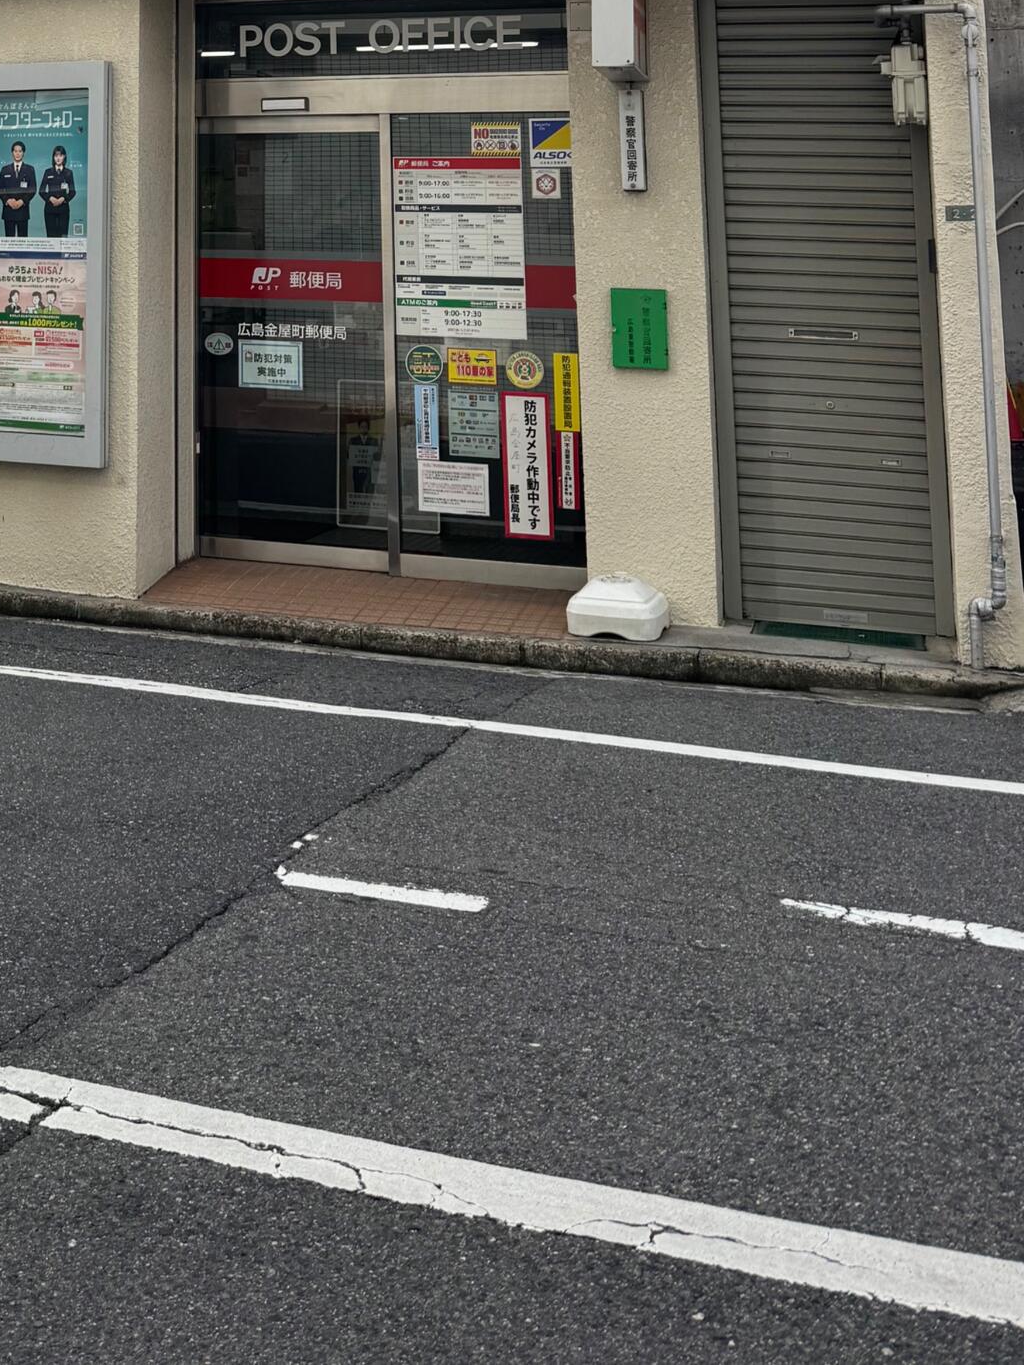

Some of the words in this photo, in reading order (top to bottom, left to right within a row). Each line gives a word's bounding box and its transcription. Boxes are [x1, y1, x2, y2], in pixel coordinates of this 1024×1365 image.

[239, 21, 345, 58] POST
[368, 15, 524, 54] OFFICE
[474, 128, 489, 139] NO
[289, 271, 342, 290] 郵便局
[238, 322, 347, 341] 広島金屋町郵便局
[254, 353, 292, 364] 防犯対策
[451, 351, 470, 363] こども
[257, 366, 287, 377] 実施中
[524, 400, 540, 530] 防犯カメラ作動中です
[510, 484, 520, 523] 郵便局長
